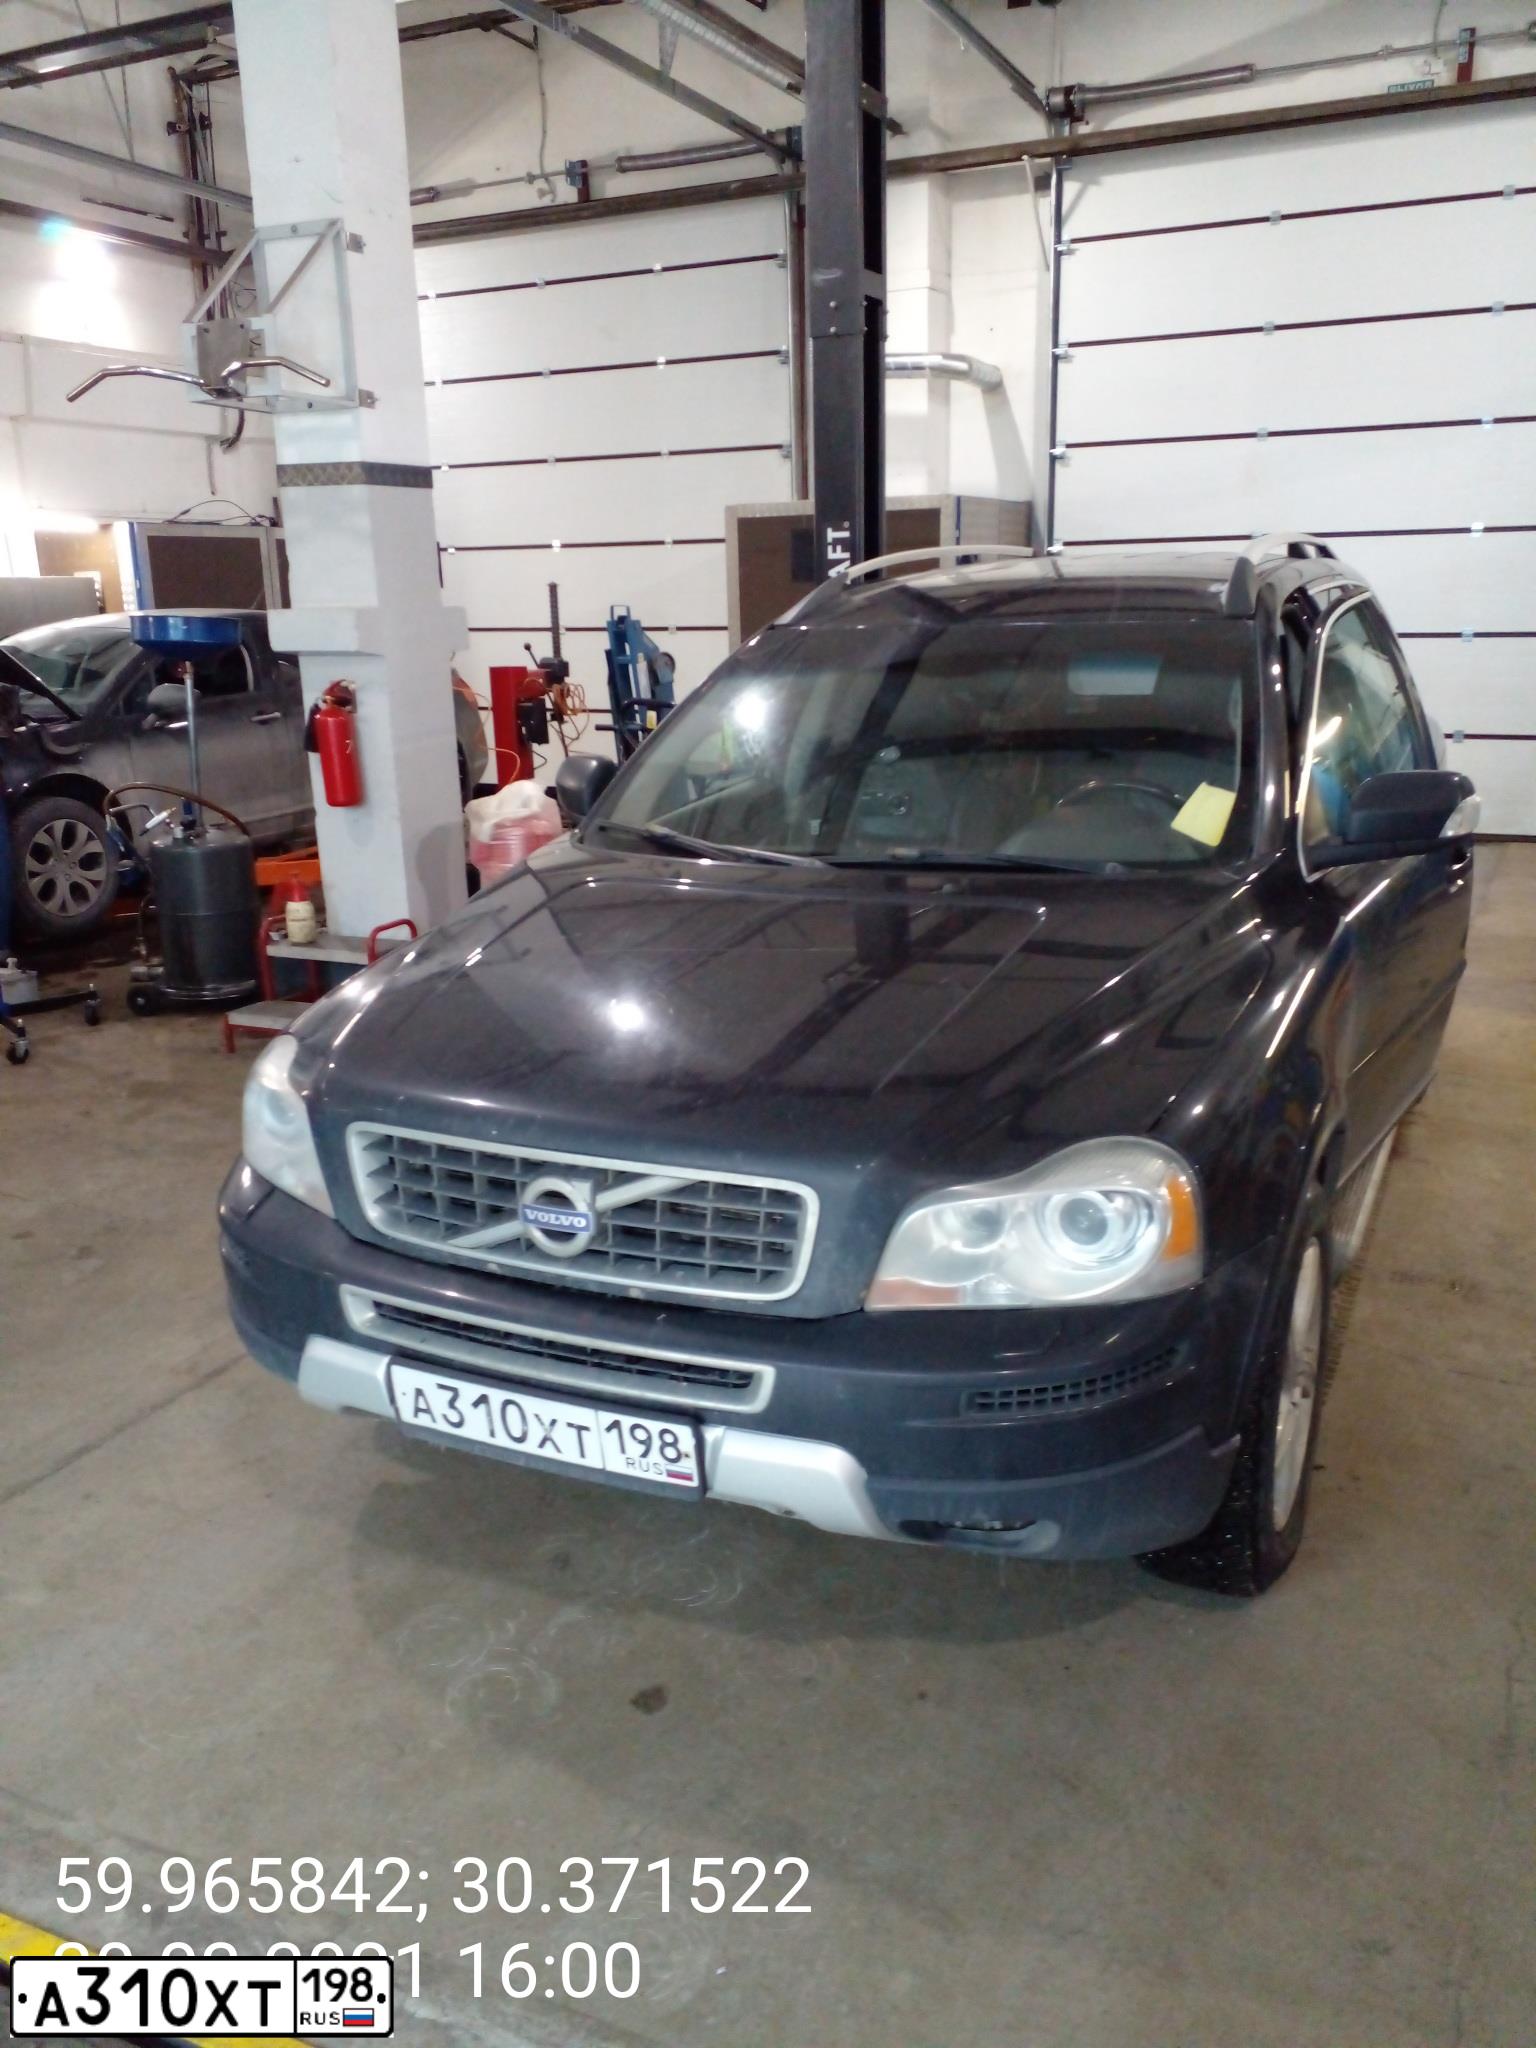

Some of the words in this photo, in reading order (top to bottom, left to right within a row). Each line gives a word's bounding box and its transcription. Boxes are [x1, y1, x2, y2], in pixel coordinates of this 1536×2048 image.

[523, 1208, 588, 1228] VOLVO
[604, 1418, 684, 1465] 198
[625, 1456, 666, 1476] RUS
